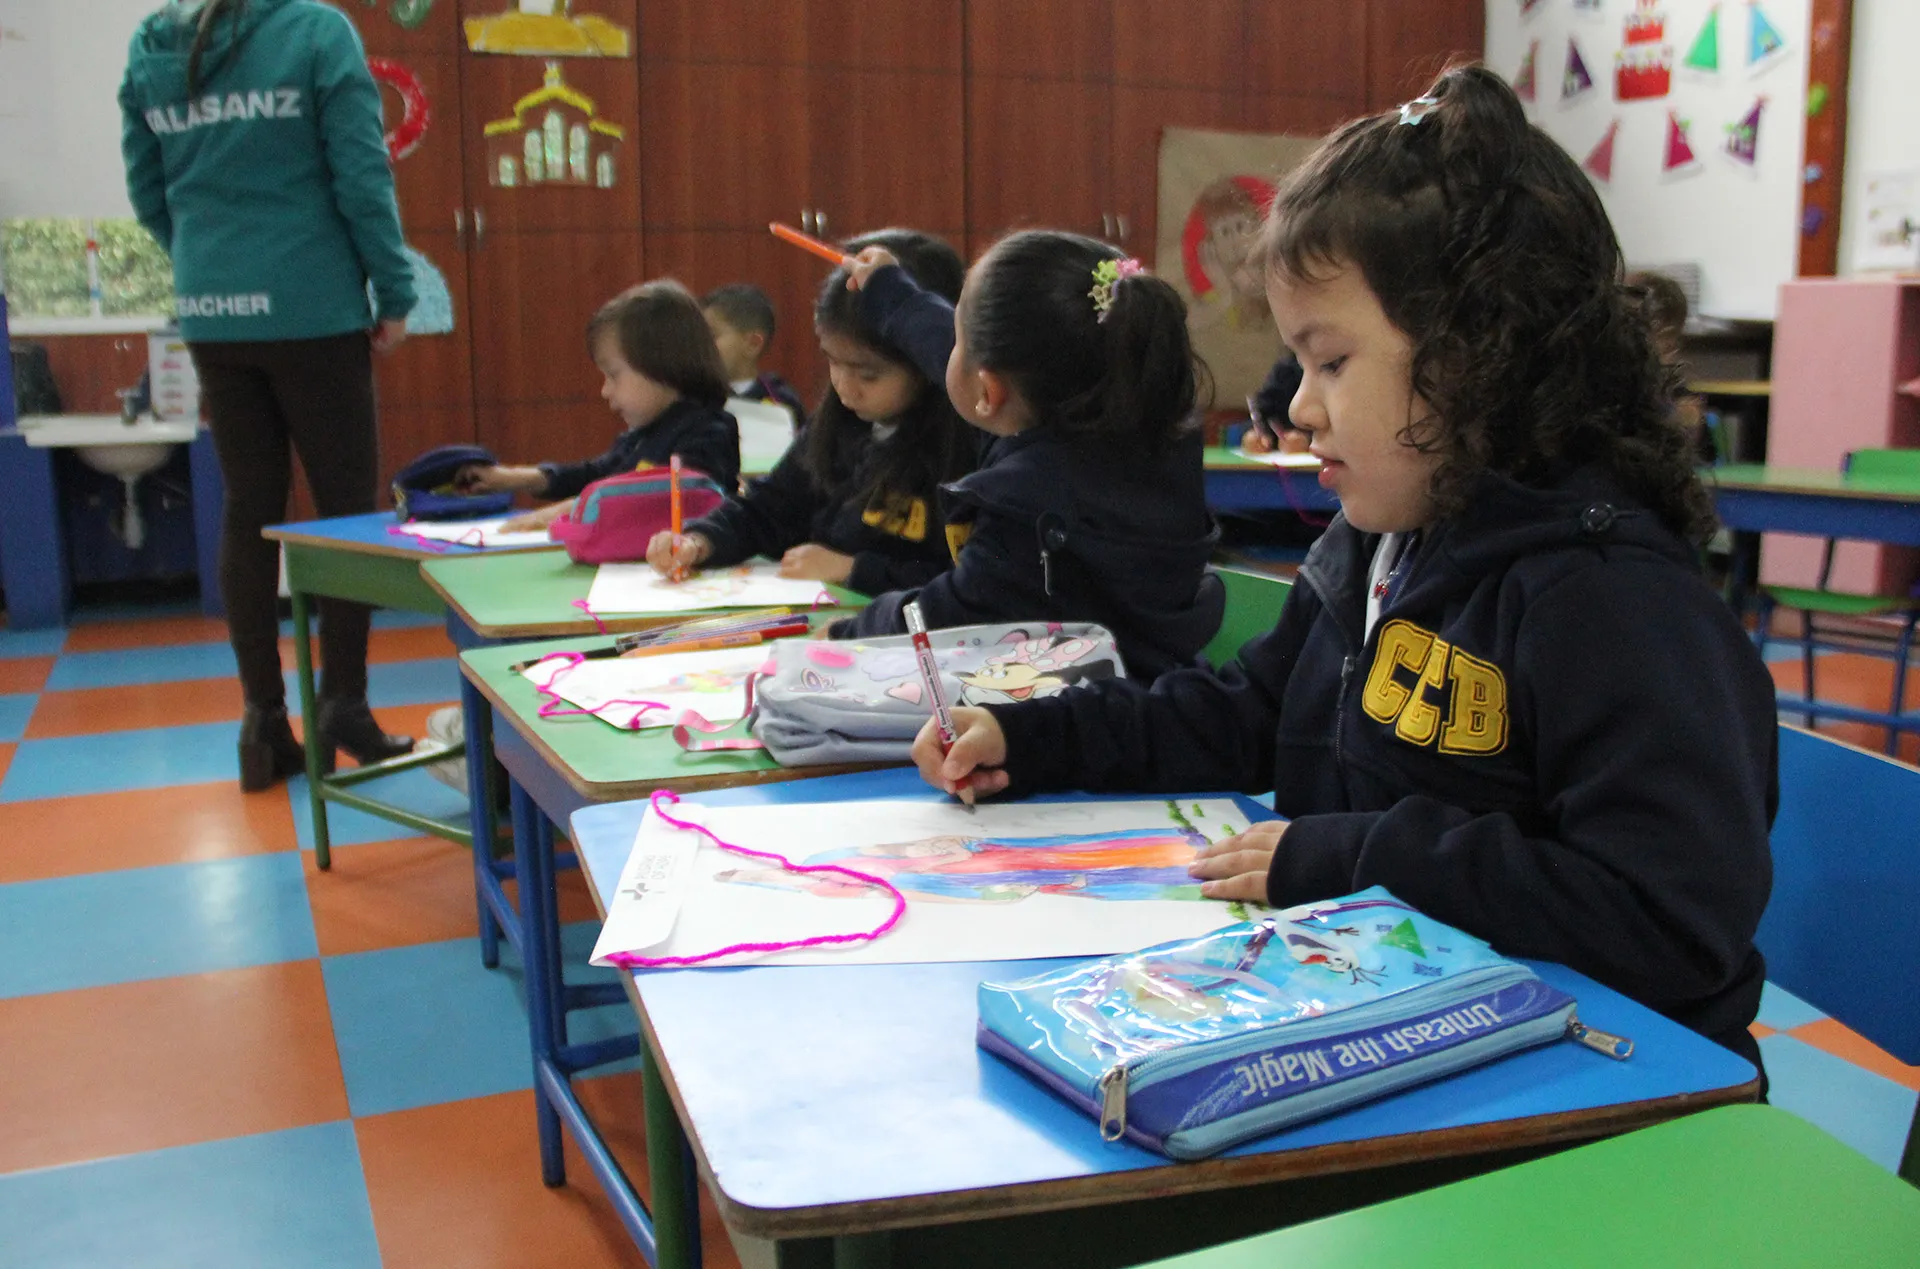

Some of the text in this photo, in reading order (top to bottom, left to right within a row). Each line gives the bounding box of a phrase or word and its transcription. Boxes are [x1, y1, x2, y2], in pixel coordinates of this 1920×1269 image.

[144, 88, 301, 134] ALASANZ
[177, 292, 270, 317] EACHER
[1363, 619, 1509, 756] CCB
[1234, 1003, 1502, 1098] Unleash the Magic
